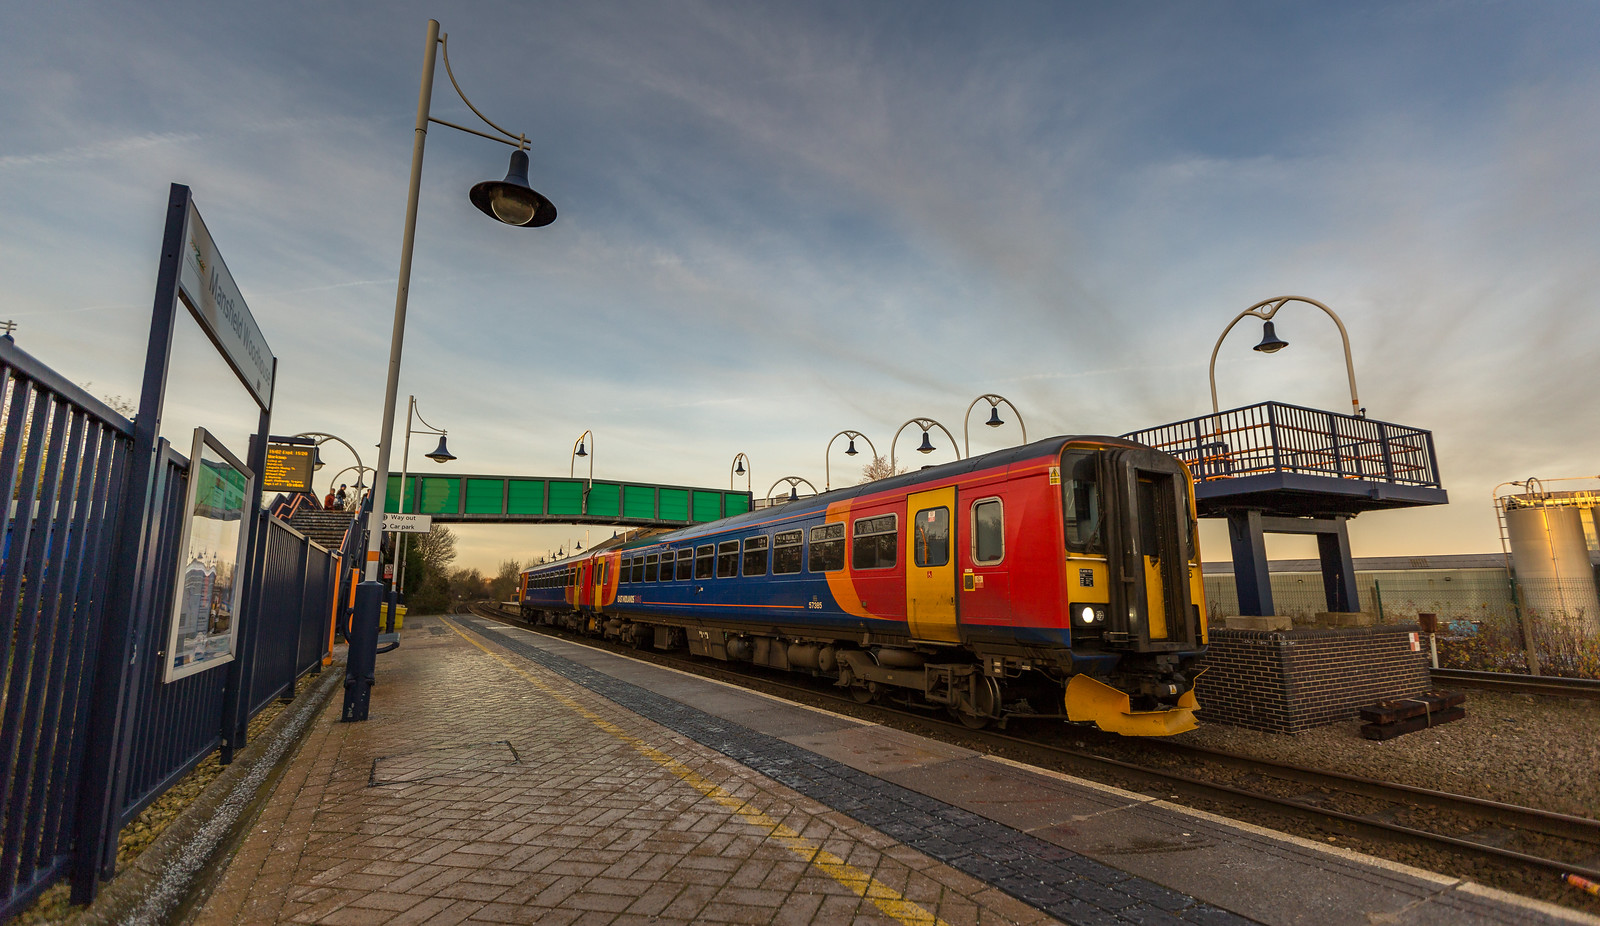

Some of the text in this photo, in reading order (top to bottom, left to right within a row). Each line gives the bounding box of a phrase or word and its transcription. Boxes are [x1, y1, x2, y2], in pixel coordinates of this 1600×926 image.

[209, 265, 270, 386] Mansfield Woodhouse
[808, 601, 823, 609] 57385
